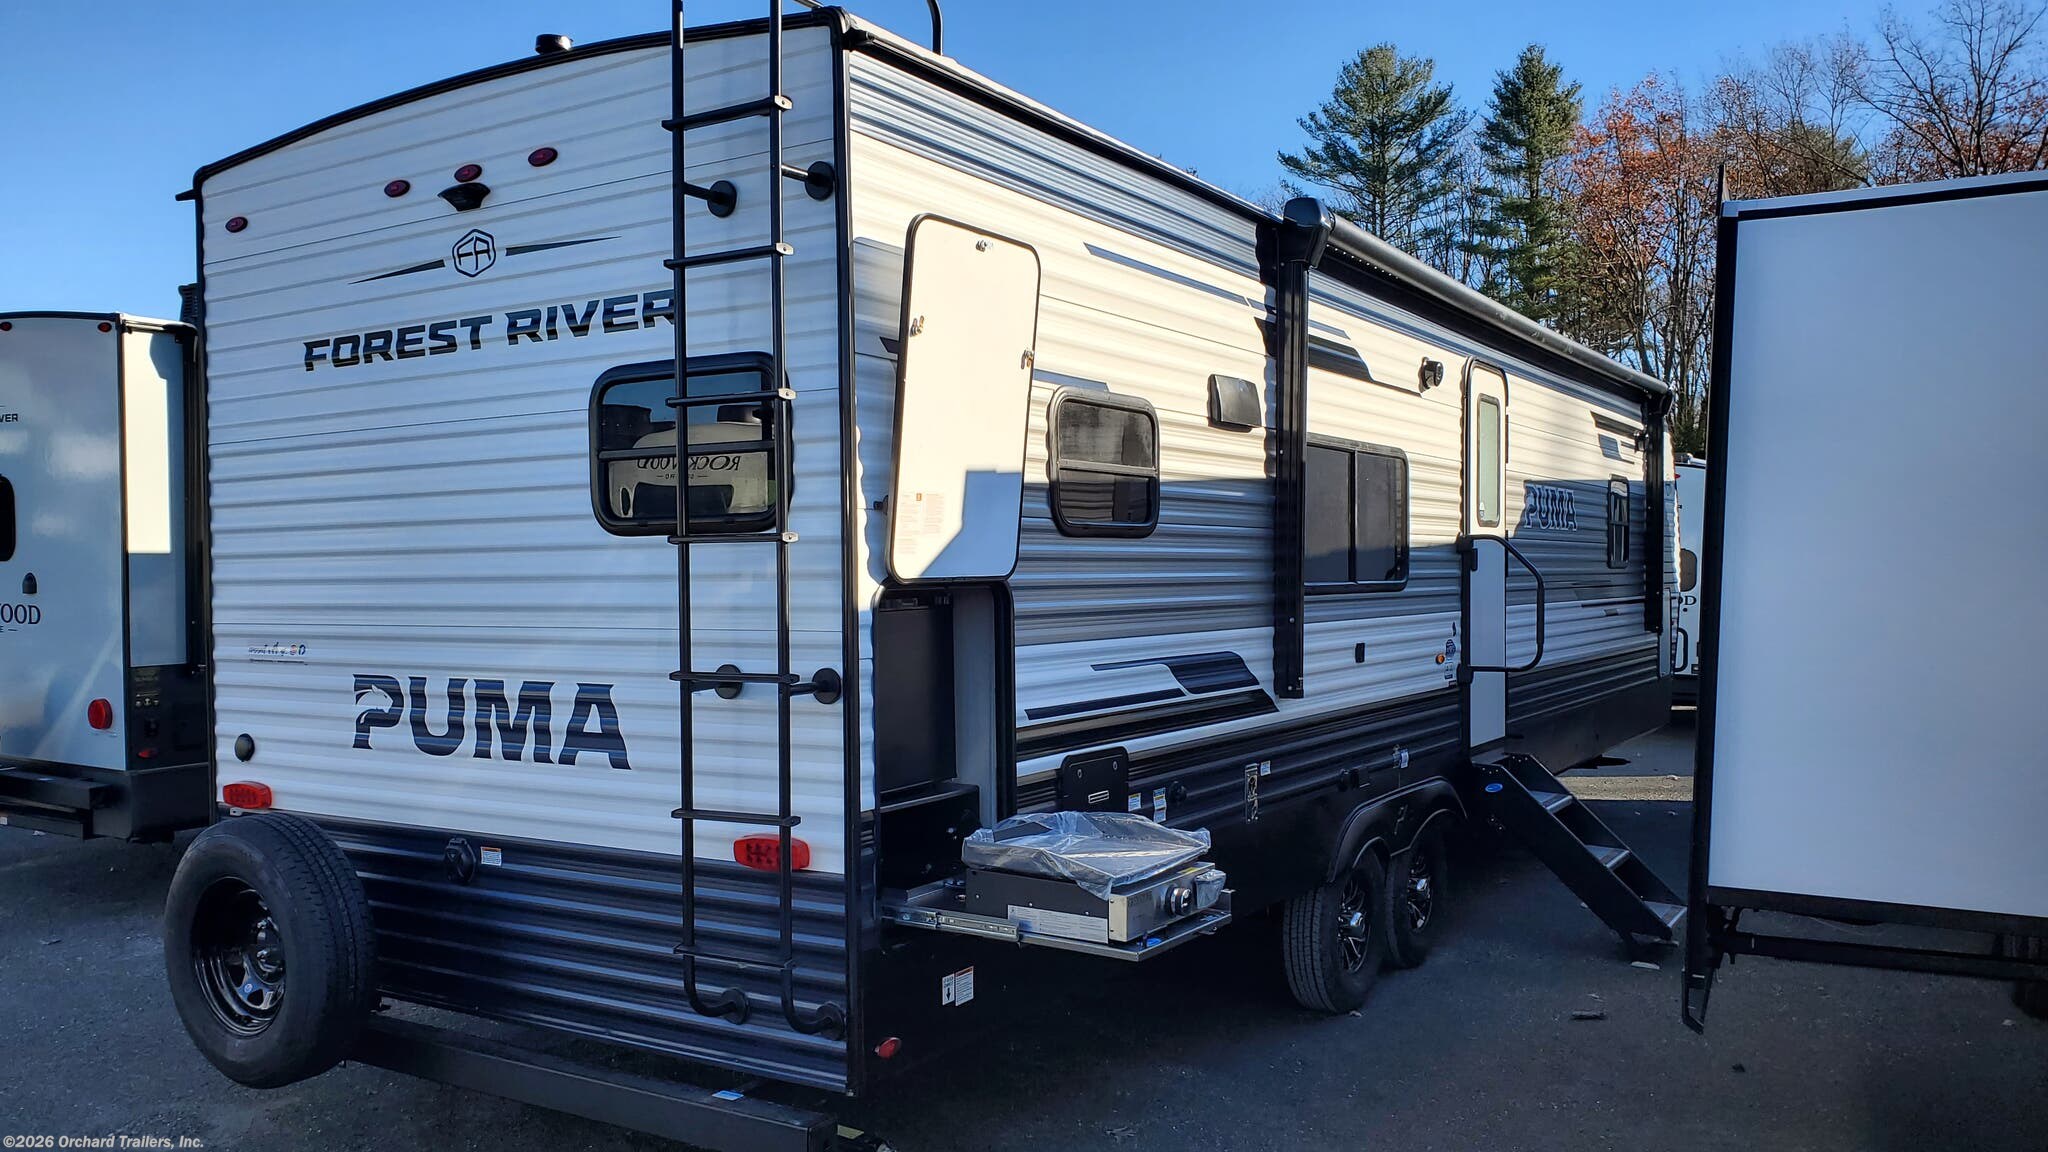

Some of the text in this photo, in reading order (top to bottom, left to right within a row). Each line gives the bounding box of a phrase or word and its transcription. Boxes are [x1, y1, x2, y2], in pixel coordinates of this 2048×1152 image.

[302, 288, 676, 372] FOREST RIVER
[1522, 483, 1577, 532] PUMA
[0, 602, 42, 625] OOD
[352, 673, 632, 771] PUMA
